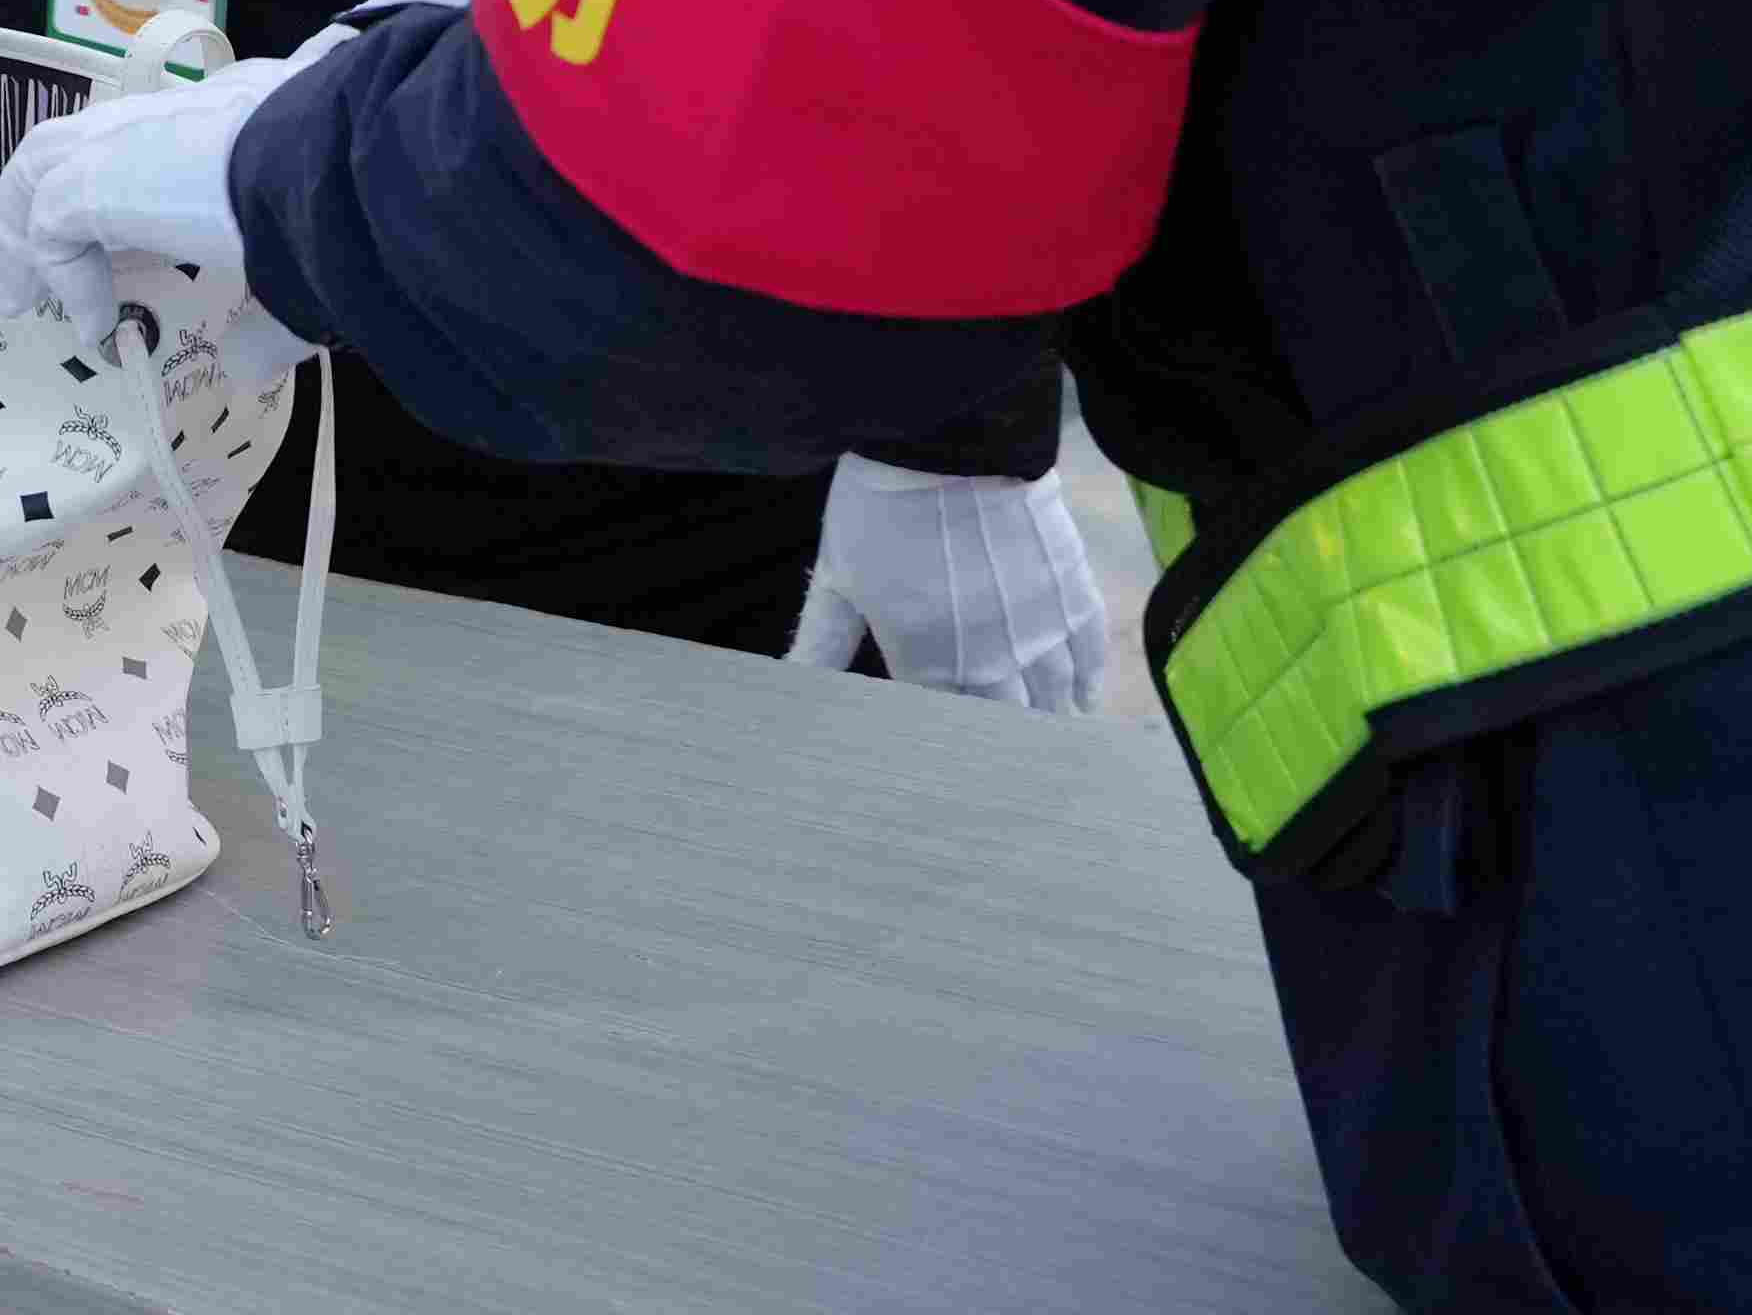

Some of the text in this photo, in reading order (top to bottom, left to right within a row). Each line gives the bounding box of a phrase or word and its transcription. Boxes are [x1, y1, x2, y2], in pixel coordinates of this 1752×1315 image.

[52, 439, 114, 483] MCM
[63, 564, 113, 600] MCM
[48, 704, 110, 743] MCM
